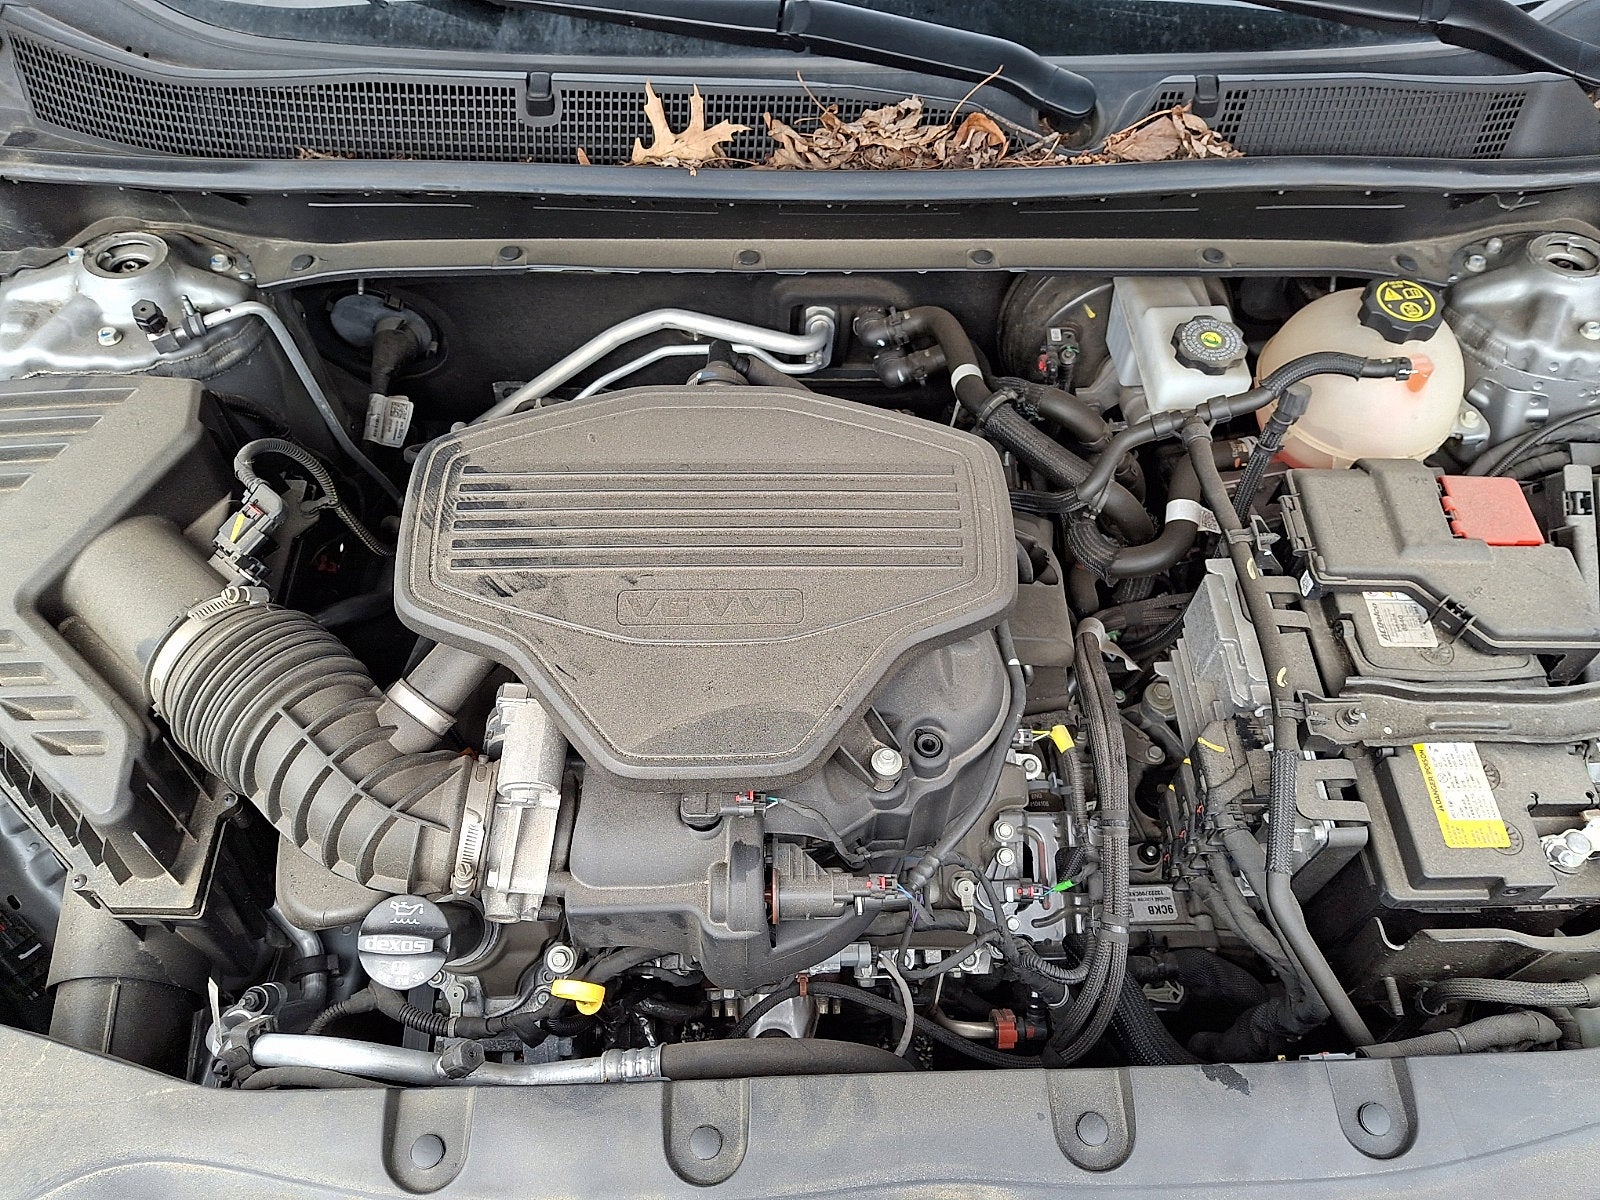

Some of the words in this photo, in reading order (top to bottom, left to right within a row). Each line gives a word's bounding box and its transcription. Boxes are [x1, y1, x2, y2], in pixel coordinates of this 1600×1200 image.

[702, 596, 796, 618] VVT
[1147, 904, 1174, 915] 9CKB
[364, 935, 426, 952] dexos
